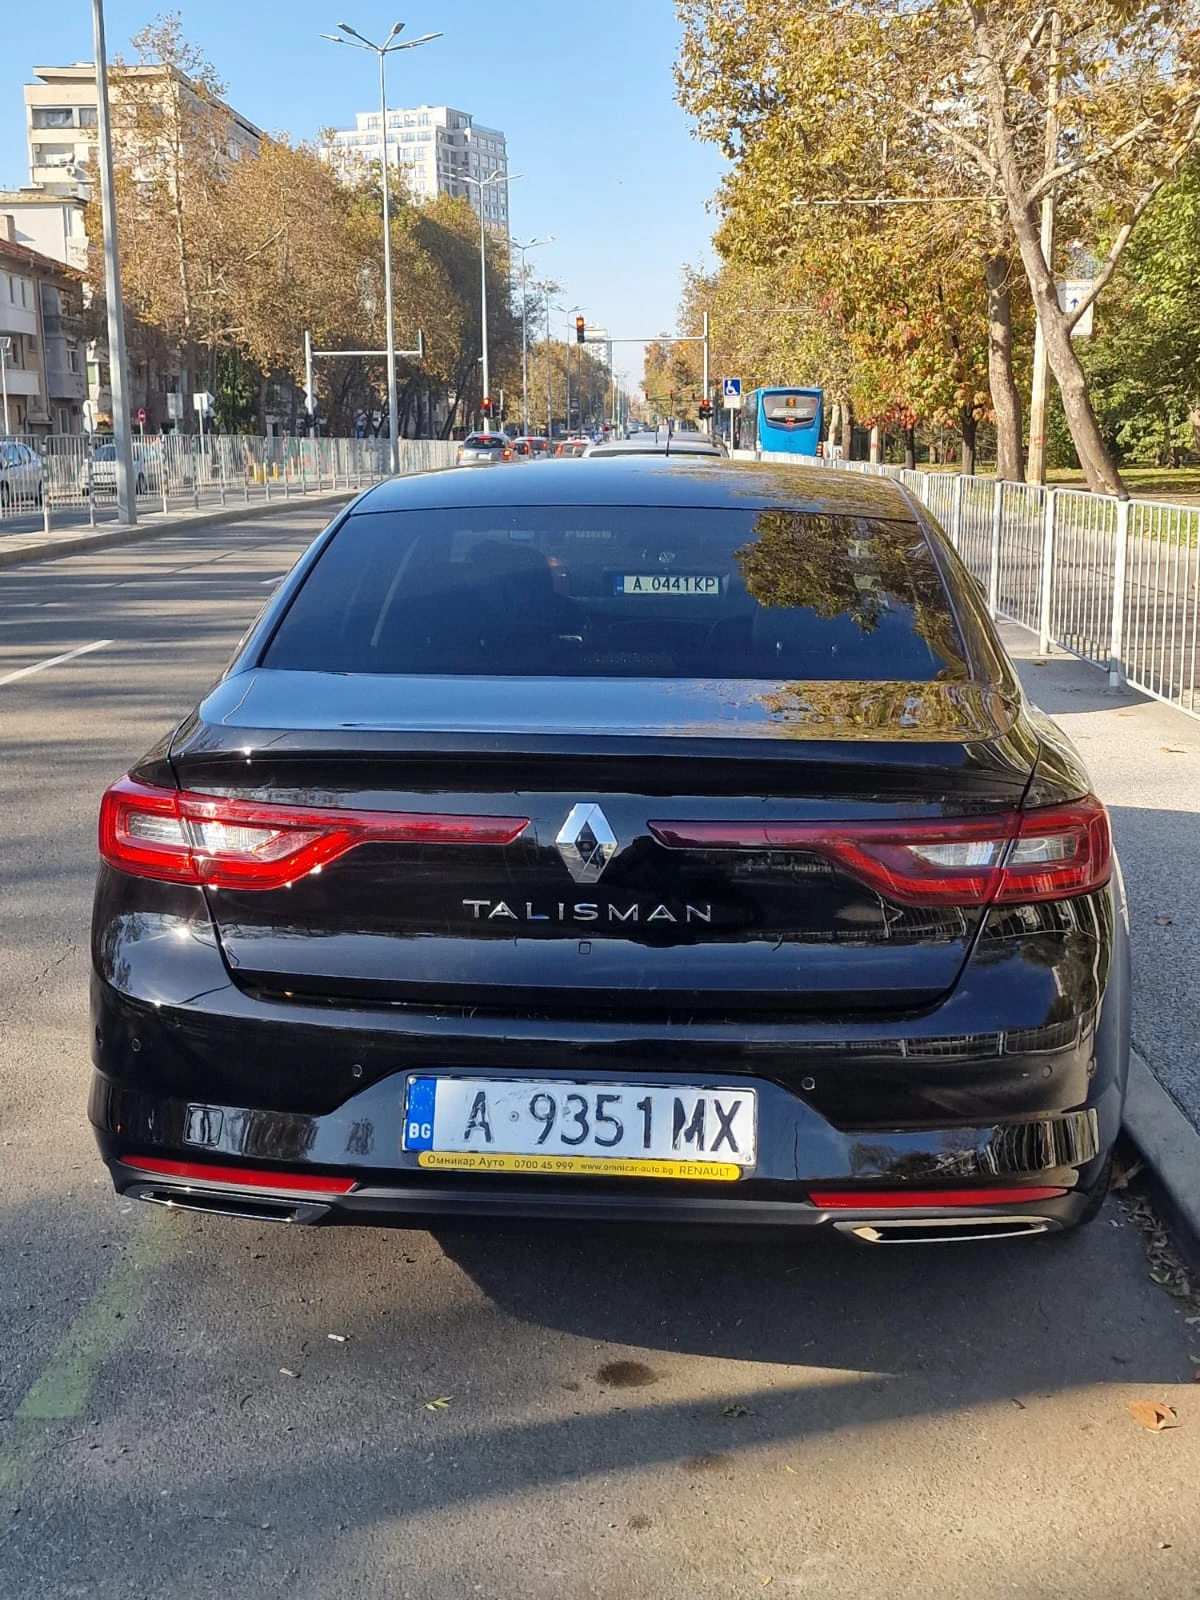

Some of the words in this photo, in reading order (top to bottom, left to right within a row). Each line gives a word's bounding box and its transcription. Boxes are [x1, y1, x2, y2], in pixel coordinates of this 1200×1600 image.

[633, 577, 642, 591] A
[462, 899, 712, 922] TALISMAN
[464, 1091, 494, 1144] A
[408, 1122, 431, 1139] BG
[427, 1154, 475, 1167] Омникар
[478, 1157, 505, 1168] Ауто
[514, 1159, 538, 1169] 0700
[541, 1161, 553, 1169] 45
[555, 1161, 574, 1170] 999
[580, 1162, 674, 1175] www.omnicar-auto.bg
[679, 1165, 731, 1177] RENAULT
